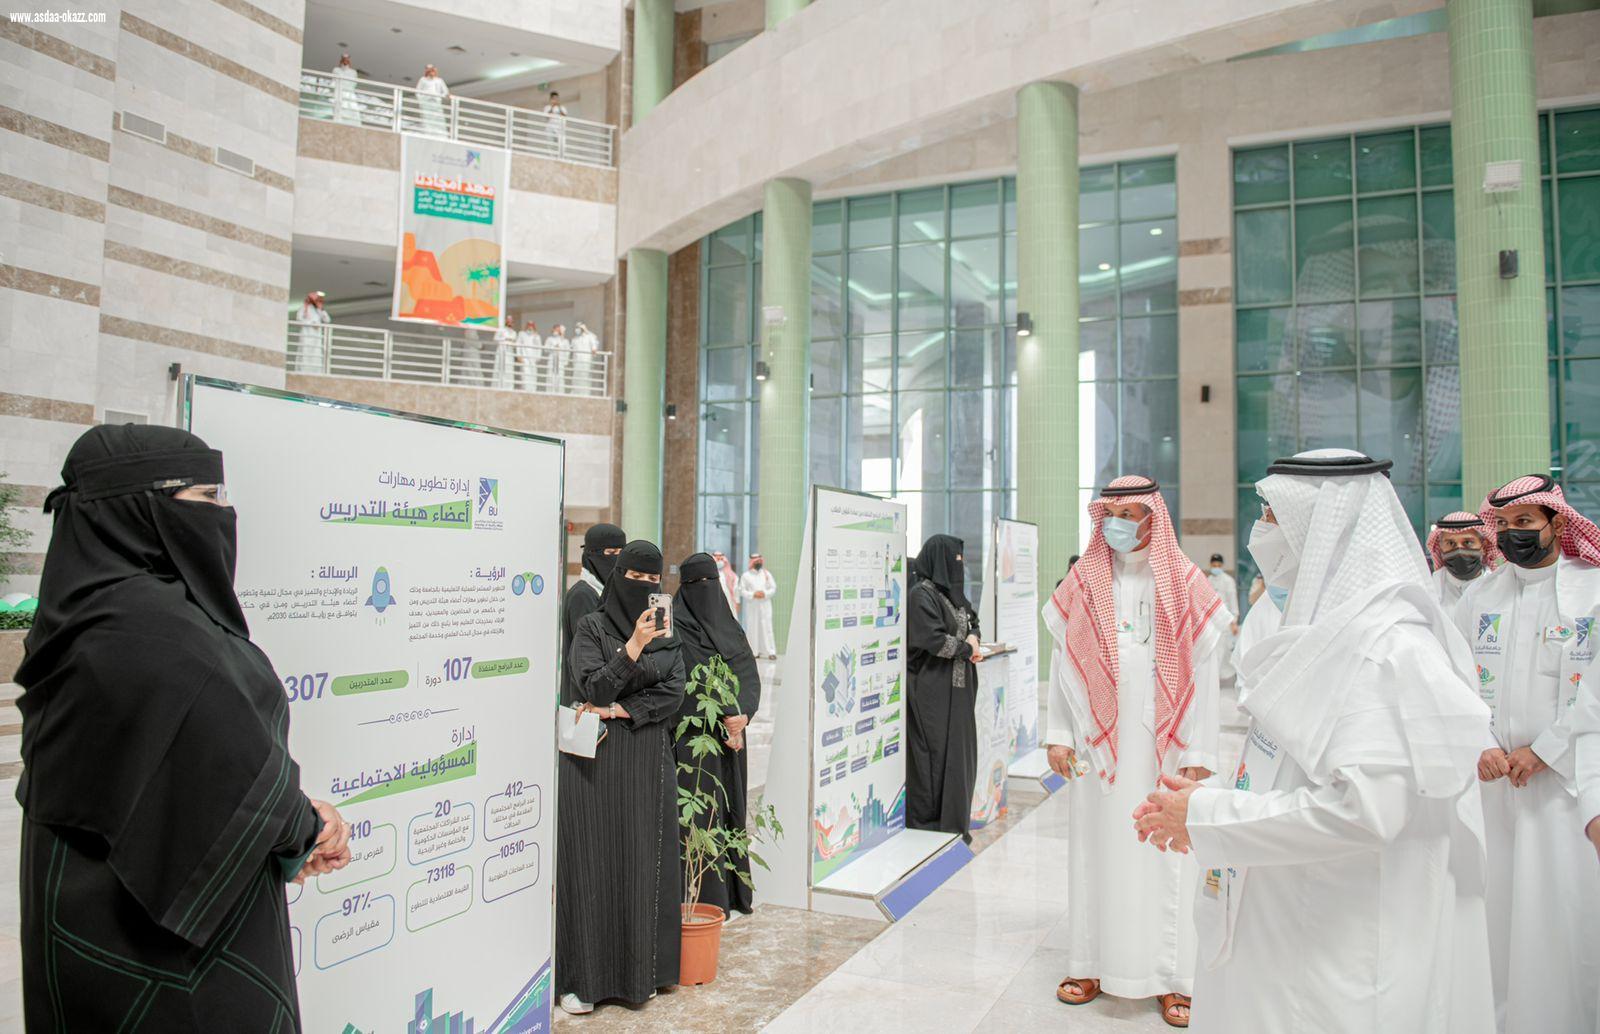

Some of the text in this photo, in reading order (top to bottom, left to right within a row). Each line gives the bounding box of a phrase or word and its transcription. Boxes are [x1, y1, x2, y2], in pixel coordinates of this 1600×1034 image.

[378, 470, 470, 496] إدارة تطوير مهارات
[319, 500, 471, 525] أعضاء هيئة التدريس
[488, 505, 498, 516] BU
[318, 565, 358, 582] الرسالة
[475, 565, 506, 581] الرؤية
[276, 589, 292, 598] مجال
[1486, 633, 1498, 643] BU
[443, 656, 473, 682] 107
[497, 661, 513, 673] البرامج
[513, 661, 525, 669] عدد
[284, 672, 329, 703] 307
[348, 676, 394, 691] عدد المتدربين
[425, 675, 442, 688] دورة
[451, 725, 475, 746] إدارة
[330, 749, 475, 797] المسؤولية الاجتماعية
[504, 780, 523, 798] 412
[434, 799, 451, 818] 20
[363, 845, 384, 861] الفرص
[500, 839, 525, 859] 10510
[426, 862, 455, 884] 73118
[355, 919, 380, 936] مقياس
